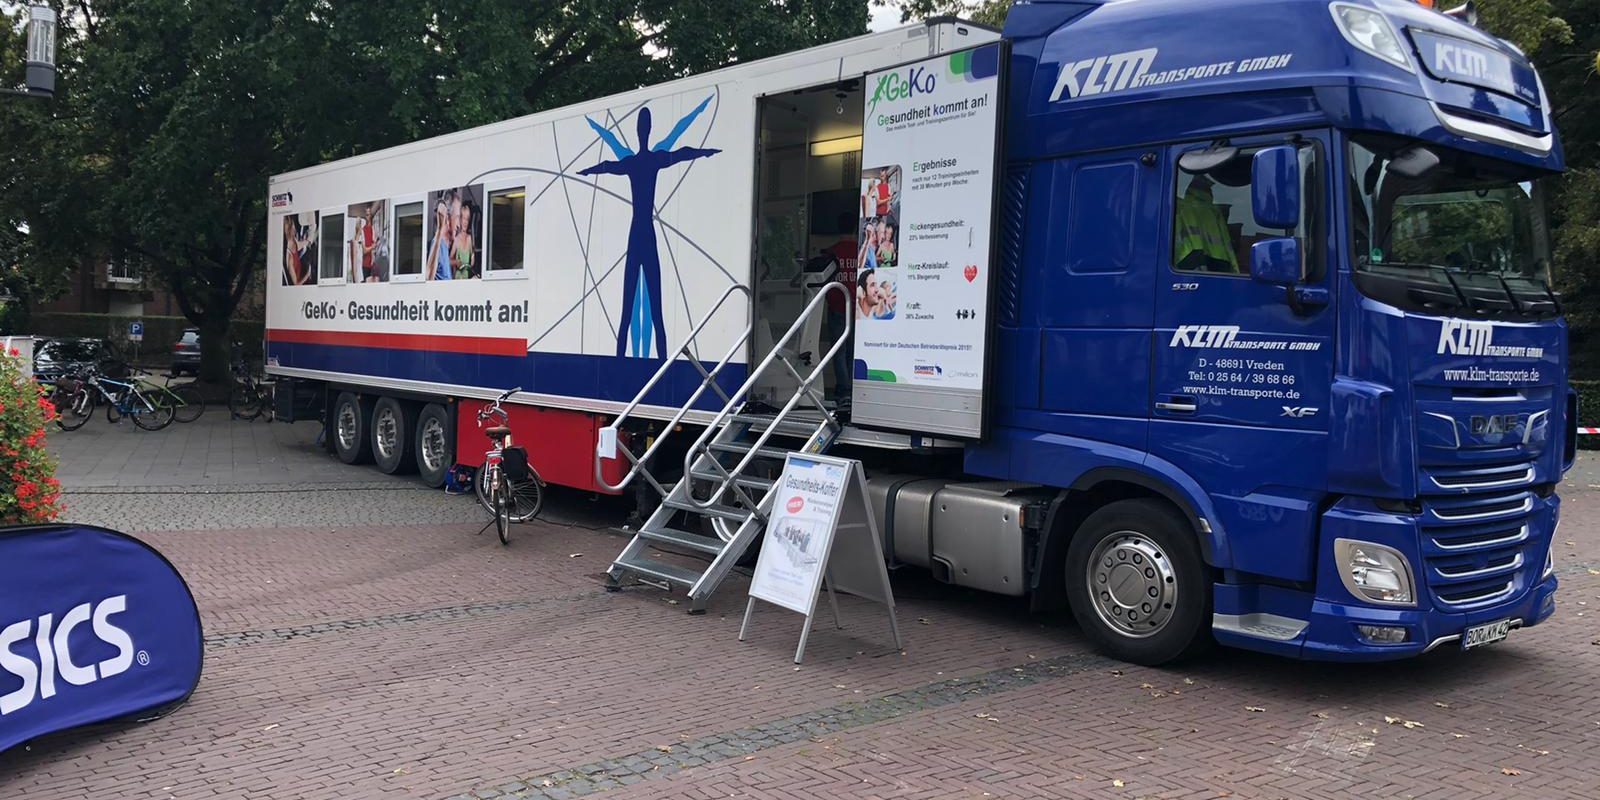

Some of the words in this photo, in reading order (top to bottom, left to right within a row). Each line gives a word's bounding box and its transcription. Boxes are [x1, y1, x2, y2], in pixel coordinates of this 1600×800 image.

[1435, 42, 1487, 80] KLM
[886, 66, 936, 101] GeKo
[1048, 47, 1158, 102] KLM
[877, 105, 931, 126] Gesundheit
[933, 98, 968, 116] kommt
[970, 93, 988, 109] an!
[912, 158, 957, 173] Ergebnisse
[907, 260, 950, 270] Herz-Kreislauf:
[1171, 283, 1199, 291] 530
[305, 301, 337, 320] GeKo
[348, 300, 429, 321] Gesundheit
[434, 300, 492, 322] kommt
[498, 300, 528, 323] an!
[906, 302, 921, 310] Kraft:
[132, 323, 140, 333] P
[1169, 325, 1240, 348] KLM
[1437, 319, 1493, 356] KLM
[1199, 358, 1207, 368] D
[1215, 358, 1244, 369] 48691
[1245, 359, 1284, 371] Vreden
[1188, 371, 1206, 381] Tel:
[1208, 372, 1215, 381] 0
[1216, 372, 1229, 382] 25
[1230, 373, 1242, 383] 64
[1244, 373, 1249, 383] /
[1252, 373, 1265, 383] 39
[1267, 374, 1280, 384] 68
[1282, 374, 1295, 385] 66
[1443, 366, 1540, 385] www.klm-transporte.de
[1183, 385, 1301, 400] www.klm-transporte.de
[1280, 405, 1319, 418] XF
[1471, 414, 1518, 434] DAF
[786, 474, 839, 497] Gesundheits-Koffer
[1466, 628, 1484, 645] BOR
